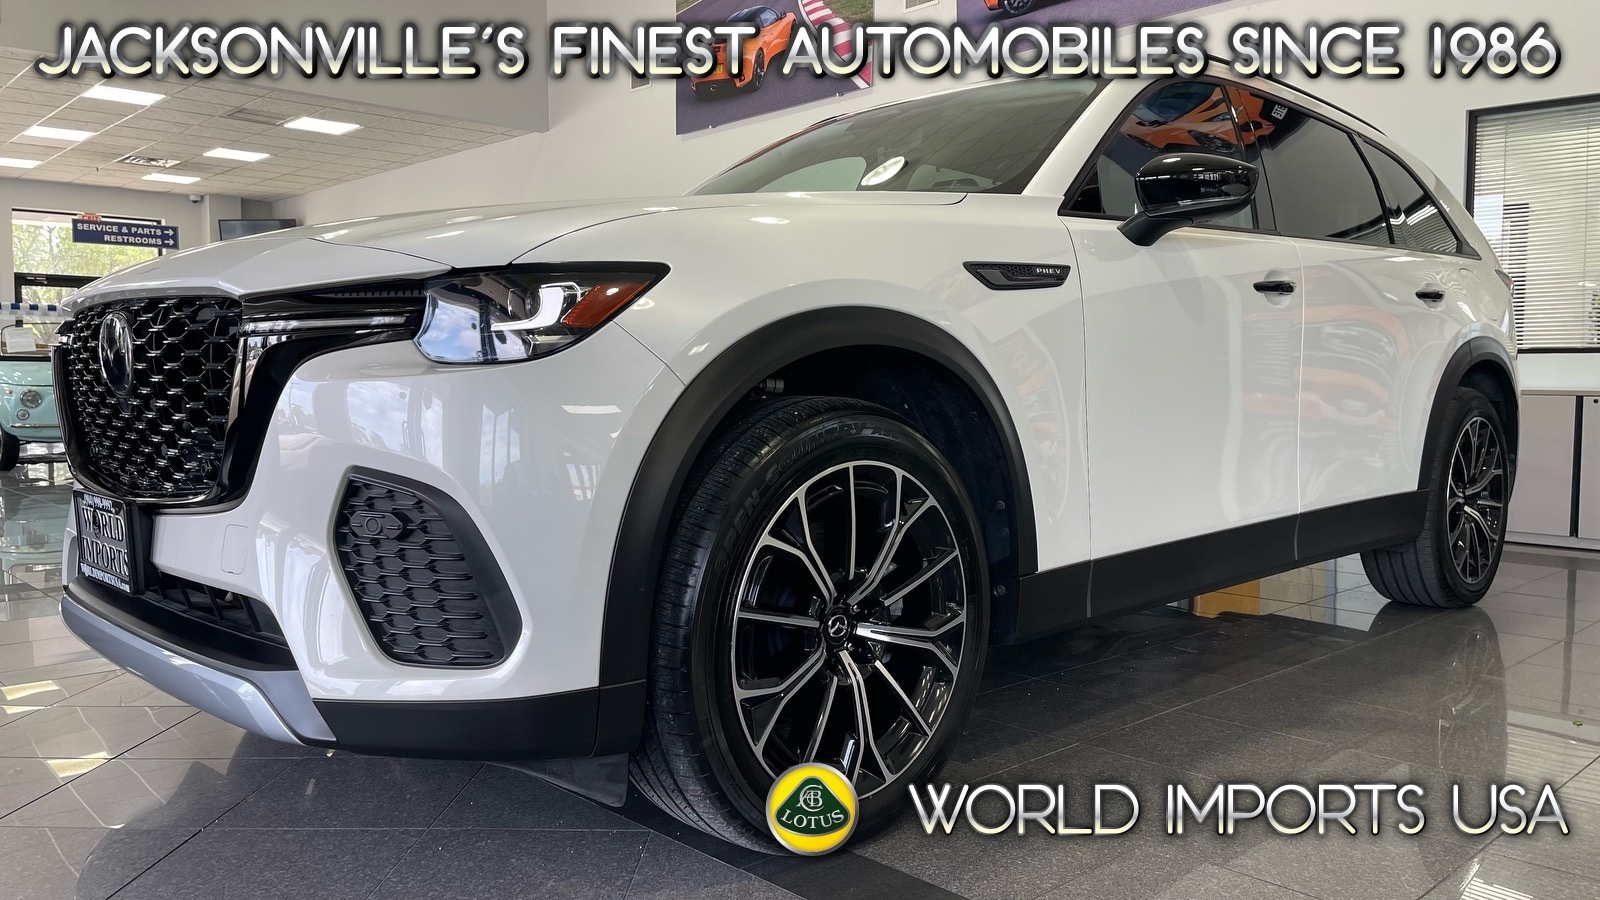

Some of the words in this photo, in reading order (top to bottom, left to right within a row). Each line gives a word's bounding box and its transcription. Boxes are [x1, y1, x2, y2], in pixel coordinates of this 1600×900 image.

[77, 223, 119, 232] SERVICE
[131, 227, 162, 235] PARTS
[104, 235, 162, 245] RESTROOMS
[81, 506, 125, 542] WORLD
[81, 535, 129, 576] IMPORTS
